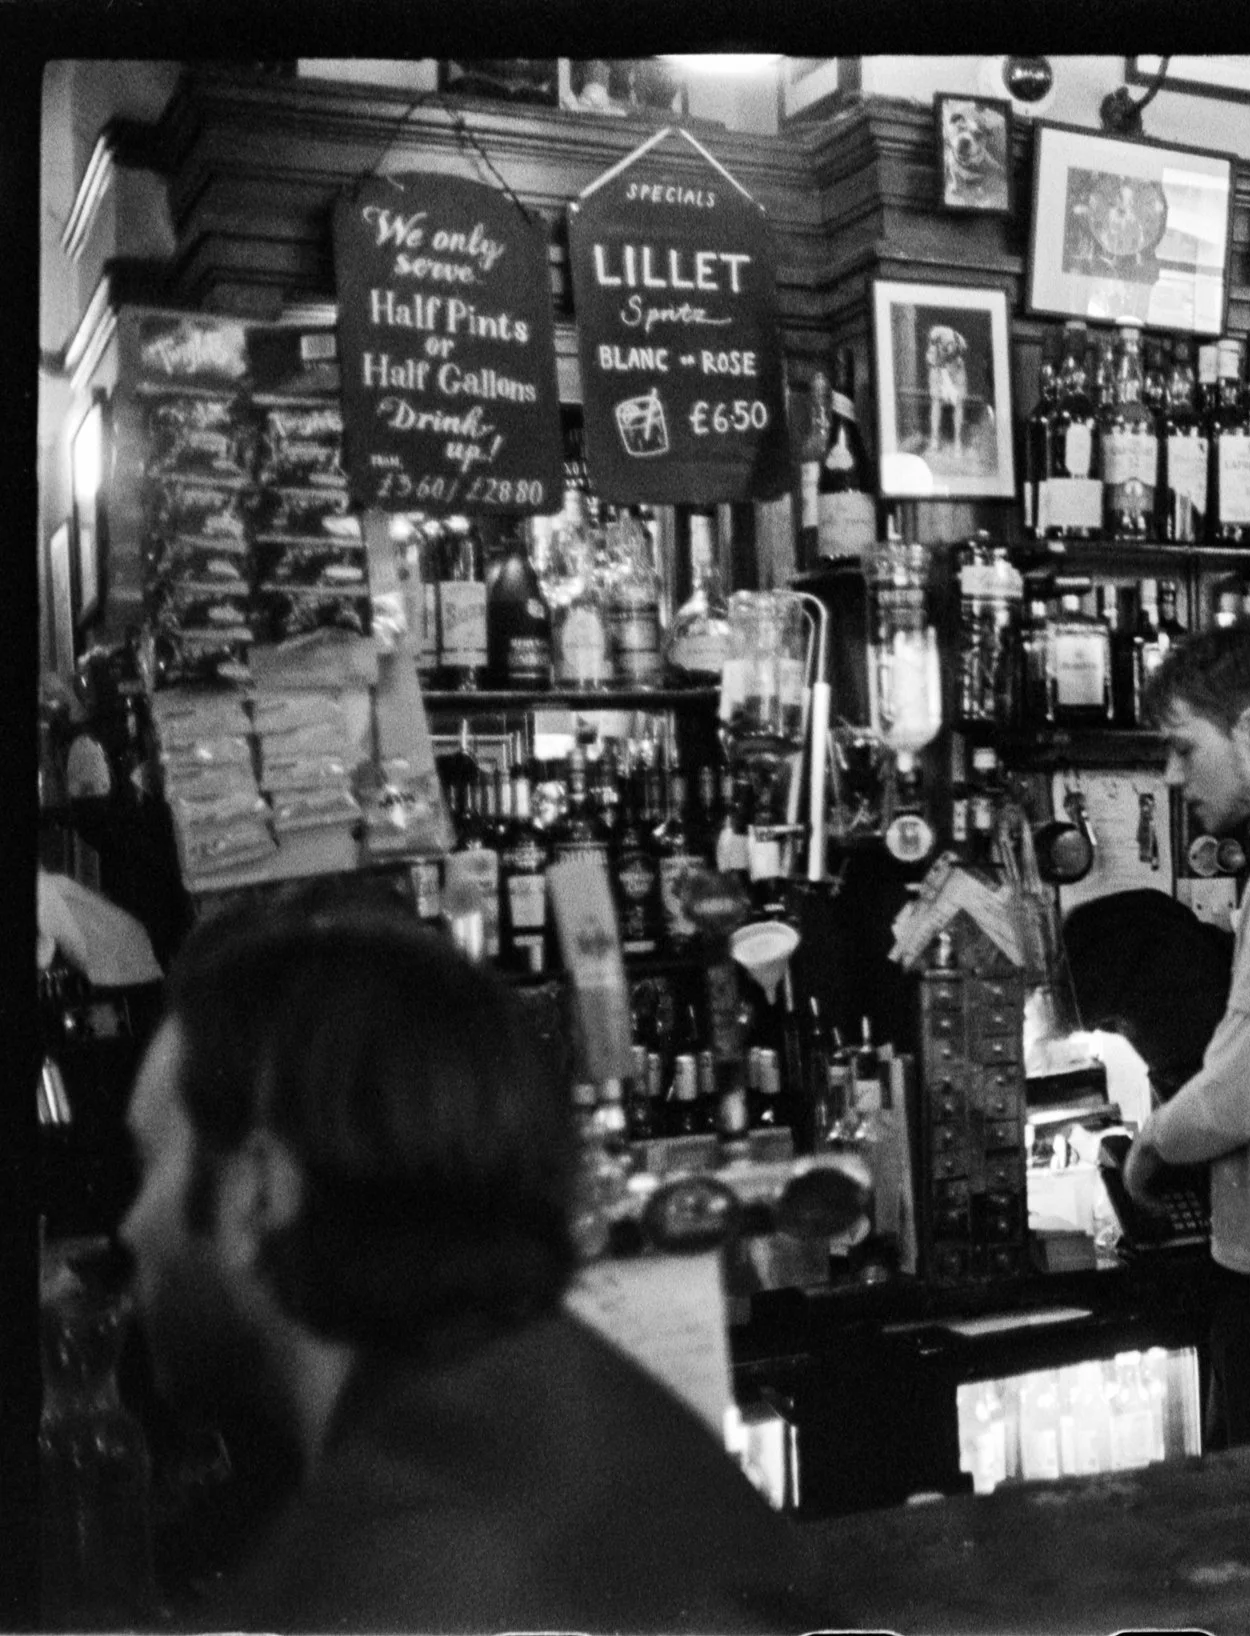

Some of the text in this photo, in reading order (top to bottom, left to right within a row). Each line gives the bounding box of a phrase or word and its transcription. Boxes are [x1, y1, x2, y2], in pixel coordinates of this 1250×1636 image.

[626, 182, 715, 208] SPECIALS
[362, 205, 506, 272] We only
[394, 253, 480, 284] serve
[593, 244, 751, 294] LILLET
[370, 288, 530, 344] Half Pints
[424, 336, 455, 358] or
[598, 344, 669, 373] BLANC
[363, 352, 537, 403] Half Gallons
[376, 395, 495, 439] Drink
[445, 434, 504, 474] up!
